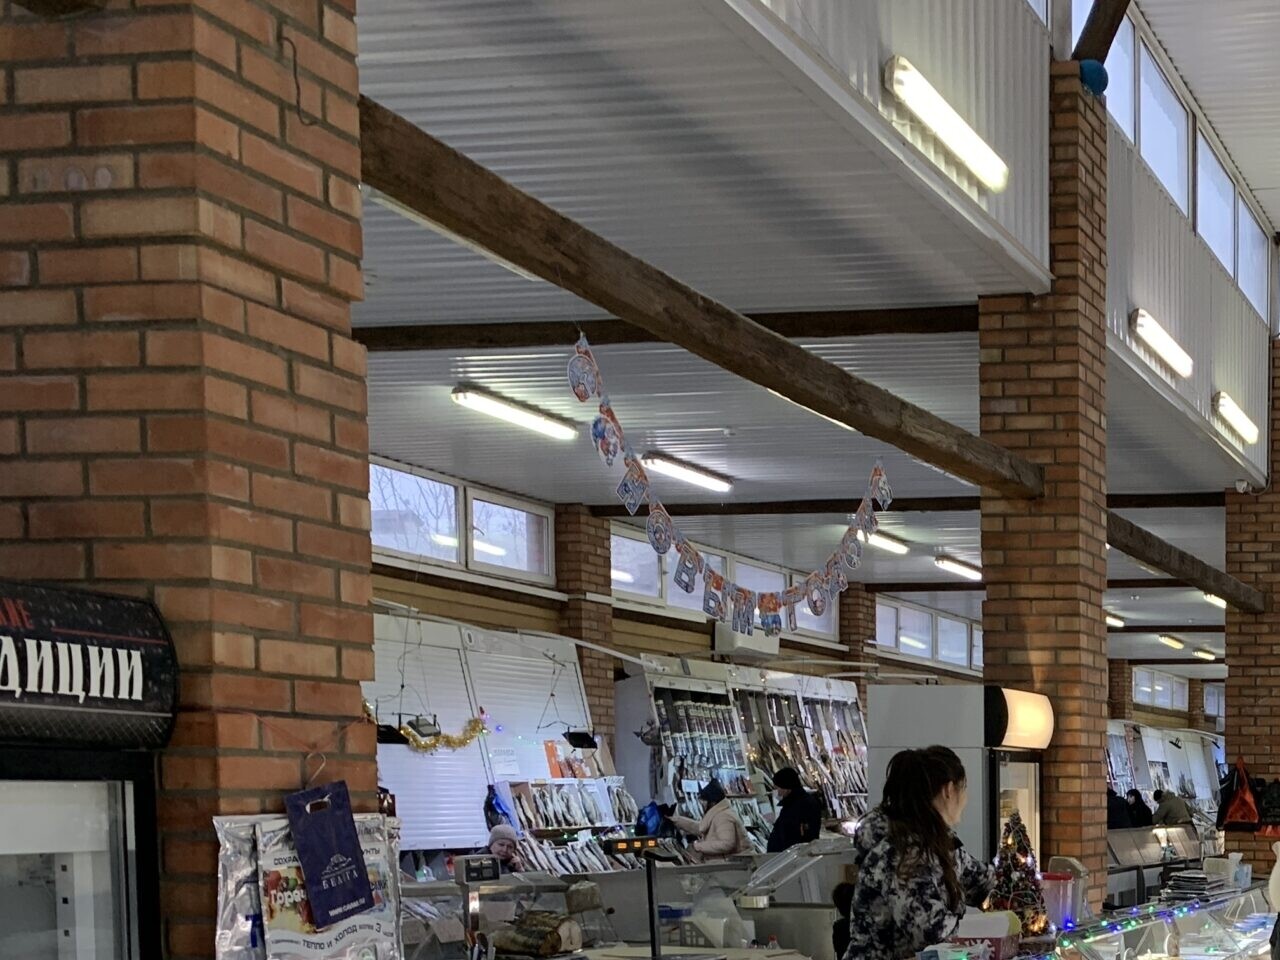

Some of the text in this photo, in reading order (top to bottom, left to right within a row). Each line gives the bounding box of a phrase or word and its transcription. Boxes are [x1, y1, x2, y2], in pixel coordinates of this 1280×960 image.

[302, 939, 325, 950] ТЕПЛО
[333, 923, 358, 944] ХОЛОД
[376, 923, 382, 933] 3
